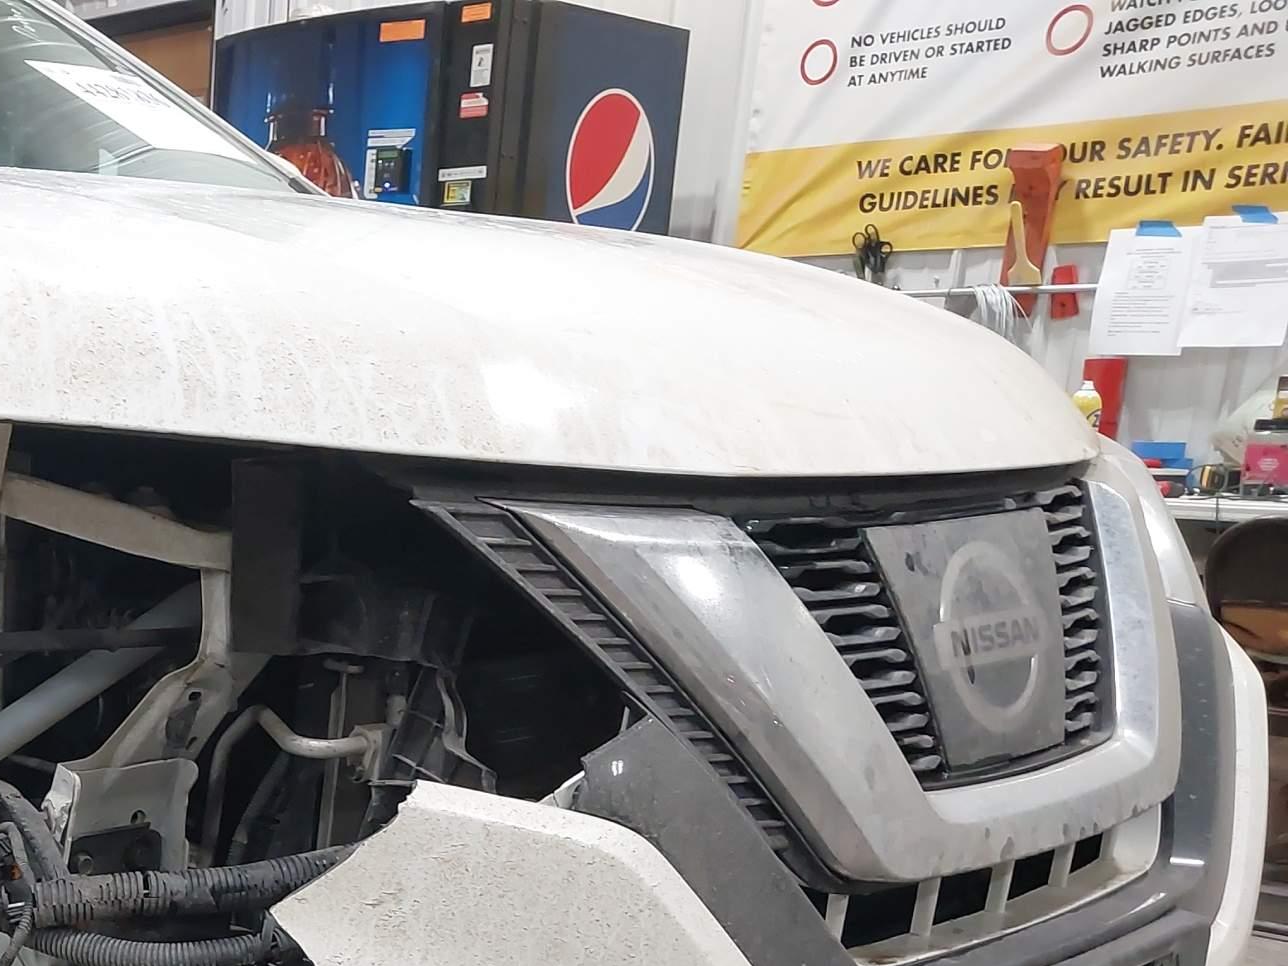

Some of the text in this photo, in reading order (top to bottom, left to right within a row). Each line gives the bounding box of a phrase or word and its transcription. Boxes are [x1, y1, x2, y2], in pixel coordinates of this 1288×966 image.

[850, 17, 1006, 48] NO VEHICLES SHOULD
[1104, 13, 1176, 35] JAGGED
[1182, 3, 1242, 25] EDGES,
[849, 37, 1012, 68] BE DRIVEN OR STARTED
[1102, 37, 1160, 57] SHARP
[1166, 26, 1231, 49] POINTS
[1236, 21, 1278, 39] AND
[847, 66, 928, 87] AT ANYTIME
[1100, 43, 1276, 78] WALKING SURFACES
[856, 158, 892, 180] WE
[899, 151, 961, 176] CARE
[1116, 128, 1224, 160] SAFETY.
[858, 184, 999, 214] GUIDELINES
[1074, 172, 1173, 200] RESULT
[1181, 168, 1216, 193] IN
[950, 617, 1040, 657] NISSAN
